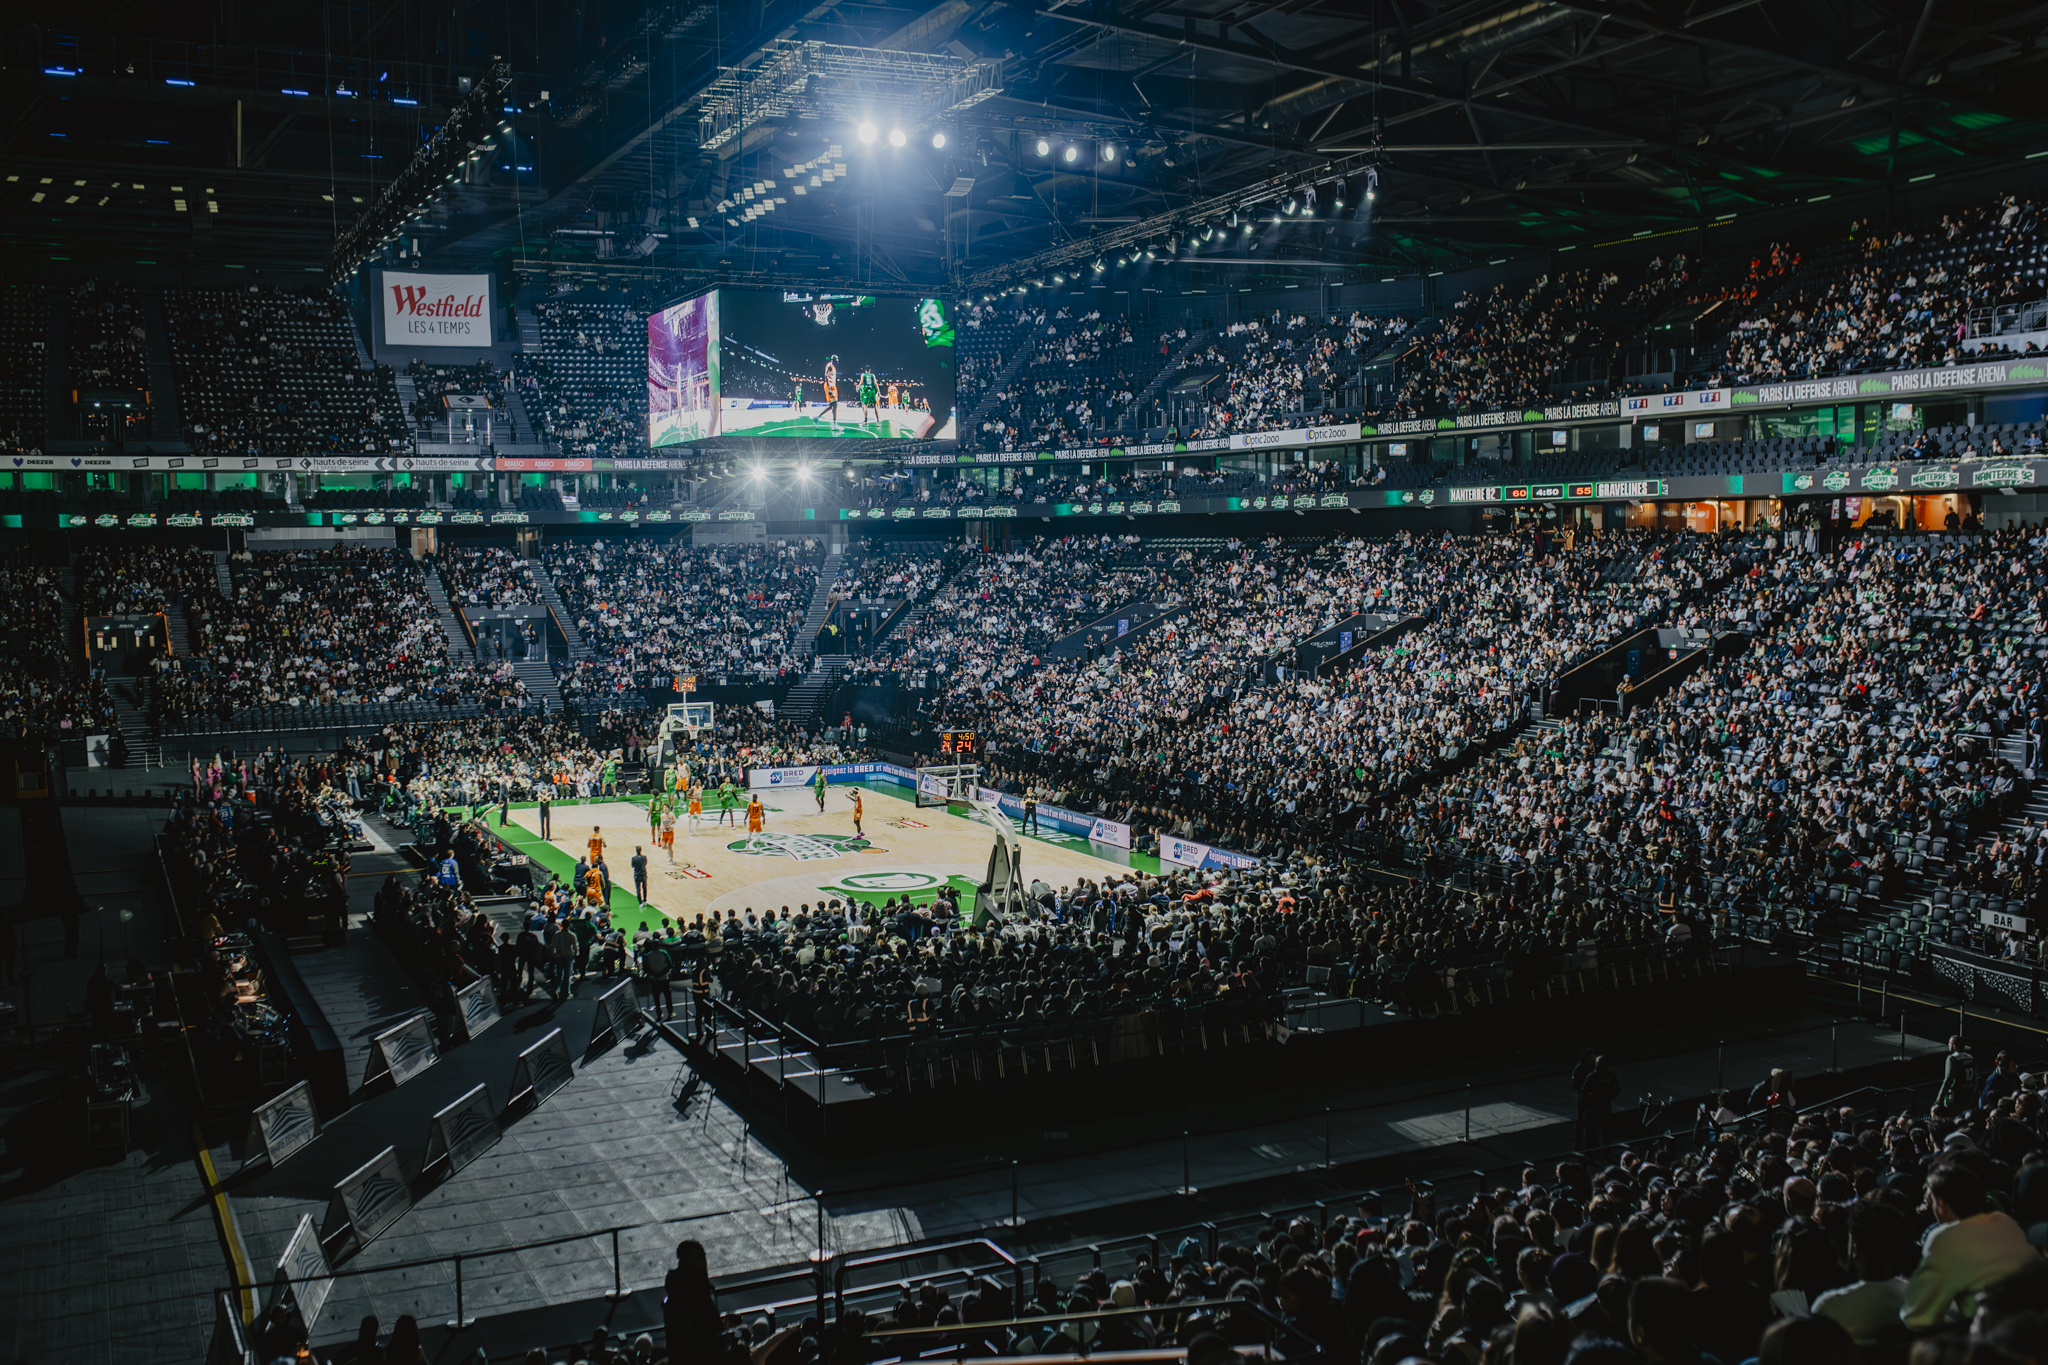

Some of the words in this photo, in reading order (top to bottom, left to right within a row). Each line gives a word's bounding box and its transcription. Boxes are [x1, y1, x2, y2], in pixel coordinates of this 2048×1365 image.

[389, 284, 487, 318] Westfield
[408, 320, 426, 334] LES
[429, 322, 434, 334] 4
[437, 322, 470, 334] TEMPS
[1892, 374, 1919, 392] PARIS
[1920, 372, 1932, 389] LA
[1933, 368, 1976, 388] DEFENSE
[1977, 366, 2006, 384] ARENA
[1759, 387, 1783, 402] PARIS
[1784, 386, 1794, 400] LA
[1794, 382, 1832, 400] DEFENSE
[1832, 380, 1858, 396] ARENA
[1544, 408, 1563, 420] PARIS
[1564, 406, 1572, 419] LA
[1572, 403, 1600, 418] DEFENSE
[1600, 402, 1619, 416] ARENA
[1456, 415, 1472, 428] PARIS
[1472, 414, 1480, 427] LA
[1480, 412, 1506, 426] DEFENSE
[1506, 410, 1522, 424] ARENA
[1378, 422, 1392, 435] PARIS
[1392, 422, 1400, 434] LA
[1400, 420, 1421, 433] DEFENSE
[1421, 419, 1436, 431] ARENA
[1246, 435, 1262, 446] Optic
[1263, 435, 1280, 444] 2000
[1309, 430, 1328, 442] Optic
[1329, 429, 1346, 438] 2000
[976, 454, 991, 462] PARIS
[992, 453, 999, 462] LA
[1000, 452, 1022, 462] DEFENSE
[1023, 452, 1037, 461] ARENA
[1055, 450, 1069, 459] PARIS
[1070, 450, 1076, 459] LA
[1077, 449, 1098, 458] DEFENSE
[1098, 448, 1110, 458] ARENA
[504, 459, 524, 467] ADAGIO
[535, 459, 554, 467] ADAGIO
[565, 459, 584, 467] ADAGIO
[614, 460, 632, 469] PARIS
[633, 460, 641, 469] LA
[642, 460, 668, 469] DEFENSE
[916, 455, 940, 464] DEFENSE
[941, 455, 956, 464] ARENA
[1913, 473, 1947, 483] NANTERRE
[1949, 473, 1958, 481] 92
[1974, 468, 2018, 482] NANTERRE
[2021, 469, 2032, 480] 92
[1450, 488, 1485, 501] NANTERRE
[1486, 488, 1496, 500] 92
[1512, 489, 1526, 497] 60
[1576, 487, 1591, 495] 55
[1599, 482, 1647, 496] GRAVELINES
[681, 683, 693, 691] 24
[958, 732, 975, 740] 4:50
[942, 740, 950, 752] 24
[957, 741, 971, 752] 24
[854, 764, 874, 773] BRED
[1104, 823, 1117, 833] BRED
[593, 840, 597, 848] 3
[1183, 844, 1198, 854] BRED
[1209, 851, 1230, 865] Rejoignez
[1232, 856, 1236, 864] la
[1994, 914, 2013, 928] BAR
